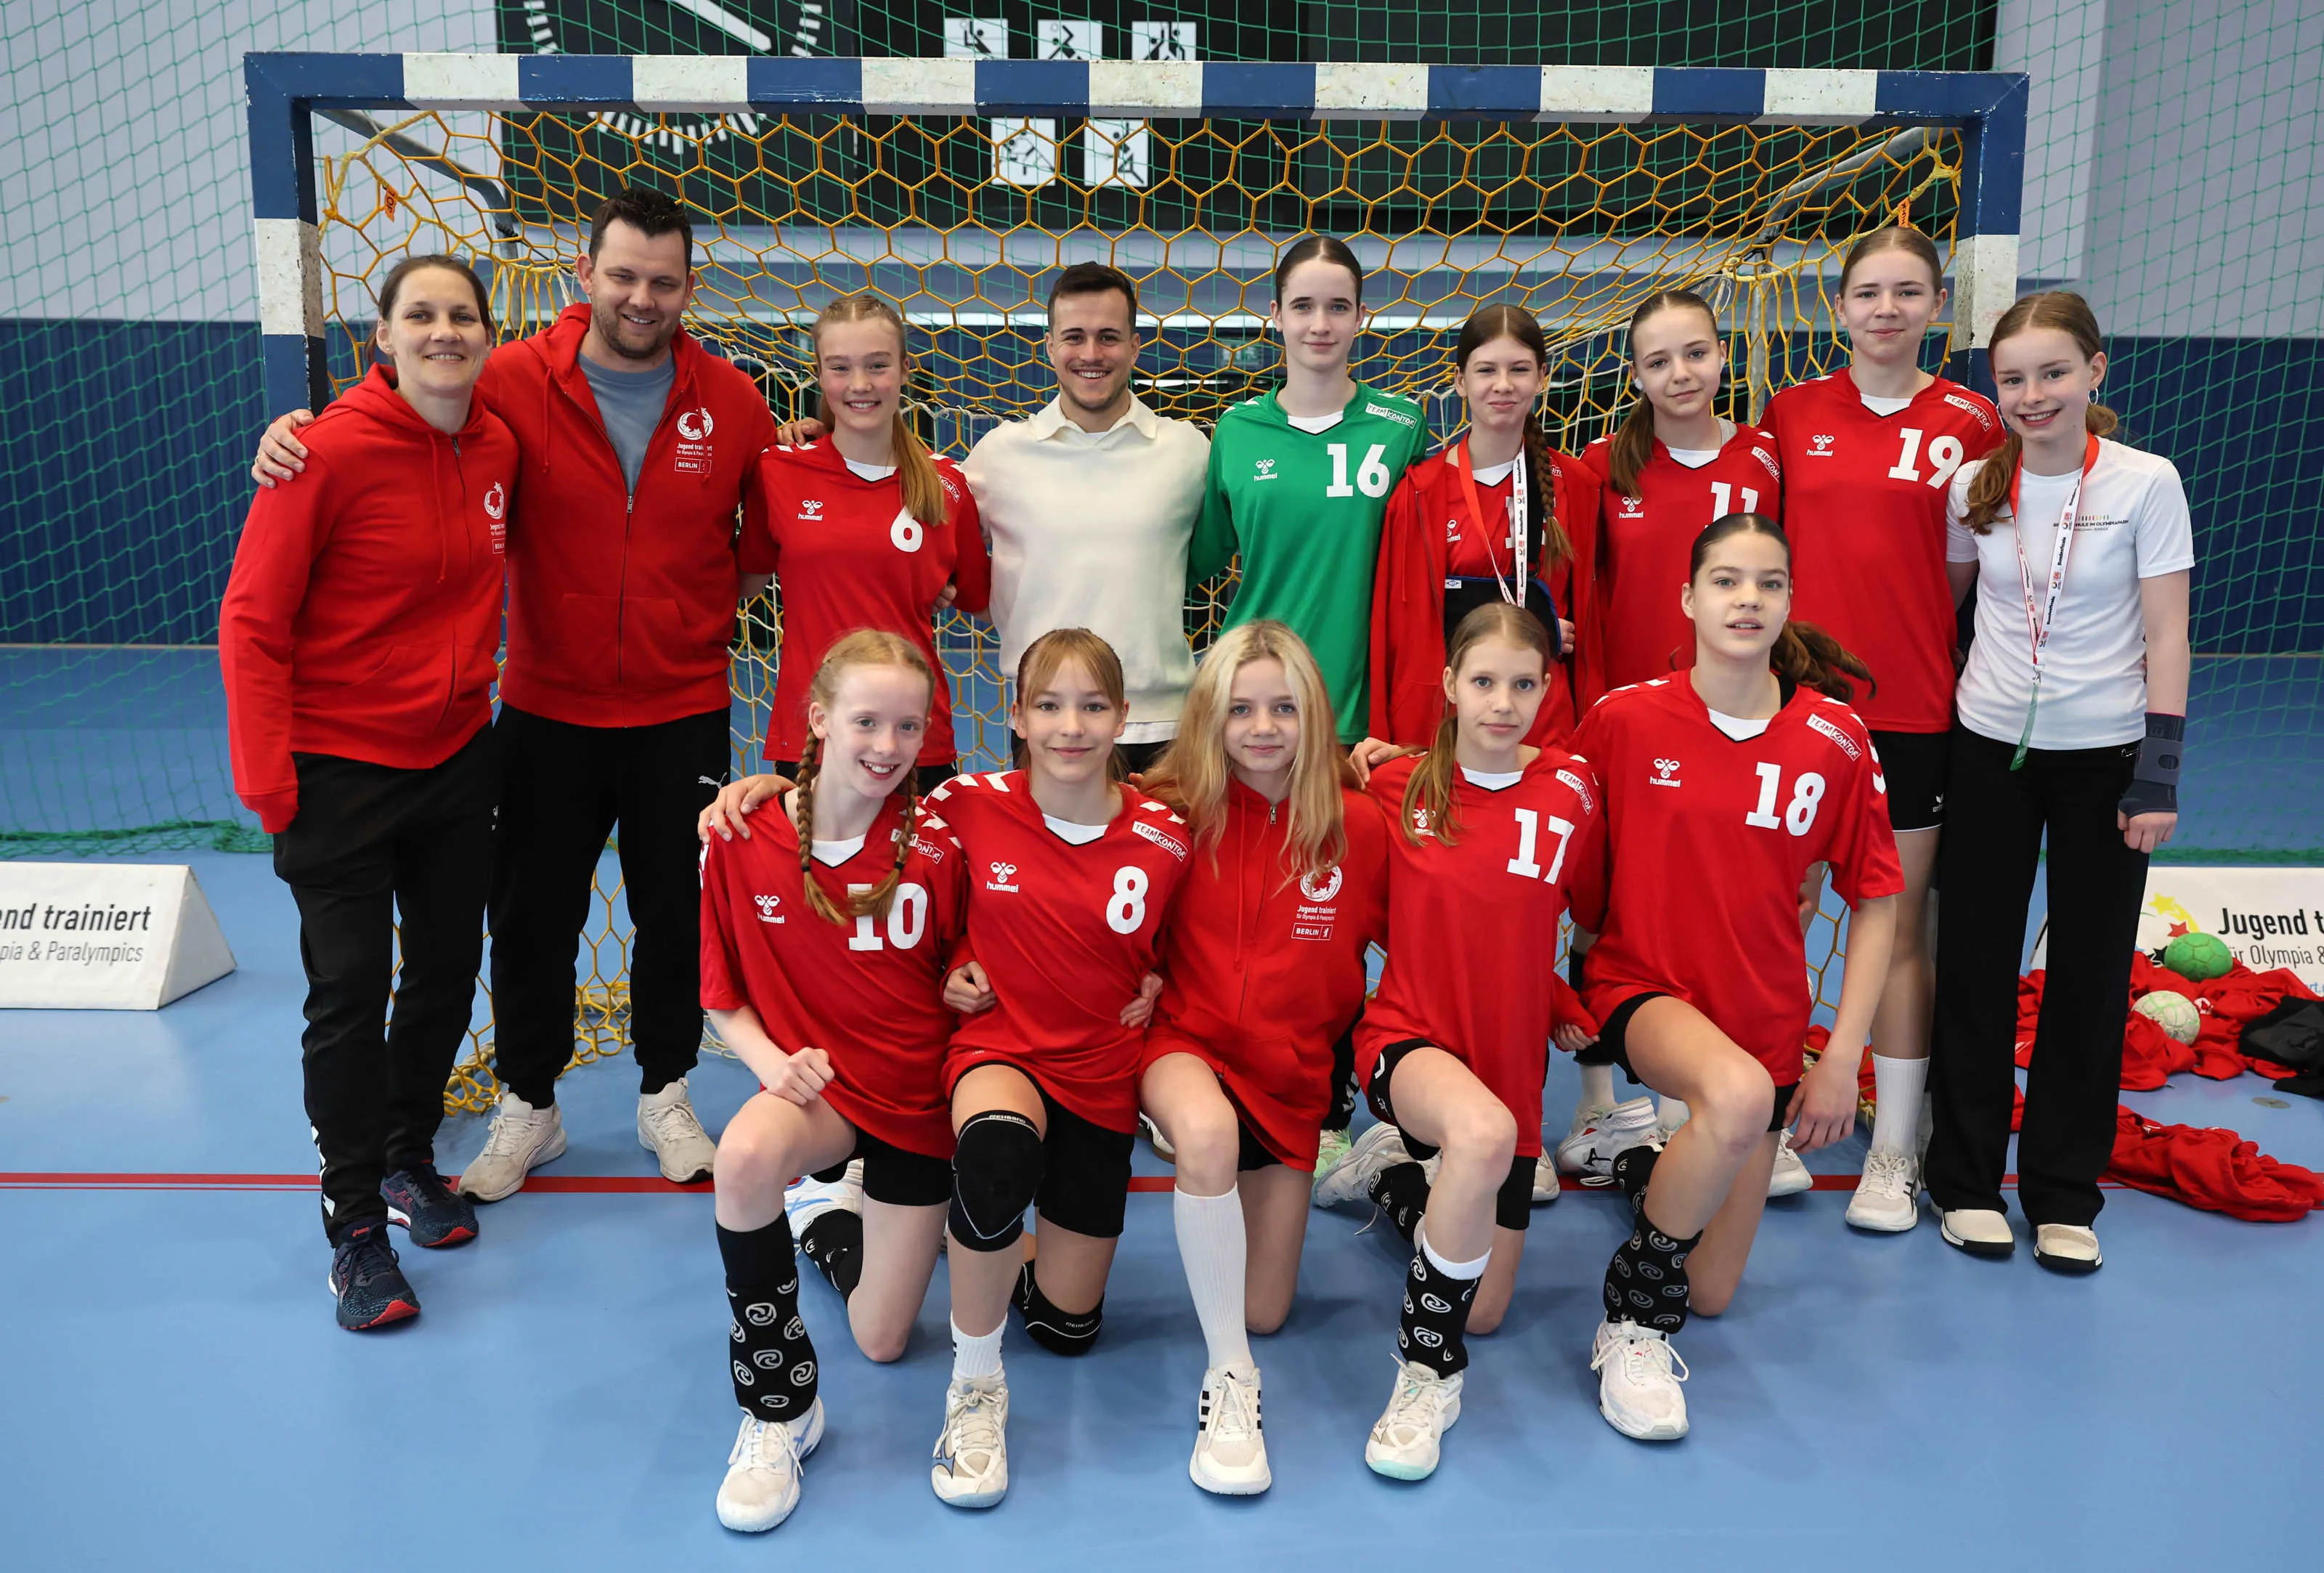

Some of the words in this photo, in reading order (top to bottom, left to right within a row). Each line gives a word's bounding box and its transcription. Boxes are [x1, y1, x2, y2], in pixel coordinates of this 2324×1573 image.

[1326, 444, 1390, 498] 16
[1888, 428, 1964, 489] 19
[1254, 473, 1277, 482] hummel
[797, 513, 823, 521] hummel
[890, 506, 923, 553] 6
[1810, 715, 1833, 735] TEAM
[1650, 776, 1681, 787] hummel
[1744, 761, 1826, 837] 18
[1135, 823, 1157, 840] TEAM
[1155, 834, 1187, 858] KONTOR
[1506, 808, 1575, 885] 17
[986, 881, 1020, 893] hummel
[1106, 866, 1149, 935] 8
[44, 904, 151, 931] trainiert
[848, 882, 928, 951] 10
[1297, 905, 1318, 914] Jugend
[2218, 908, 2308, 940] Jugend
[28, 941, 41, 961] &
[46, 941, 144, 966] Paralympics
[2250, 945, 2314, 970] Olympia
